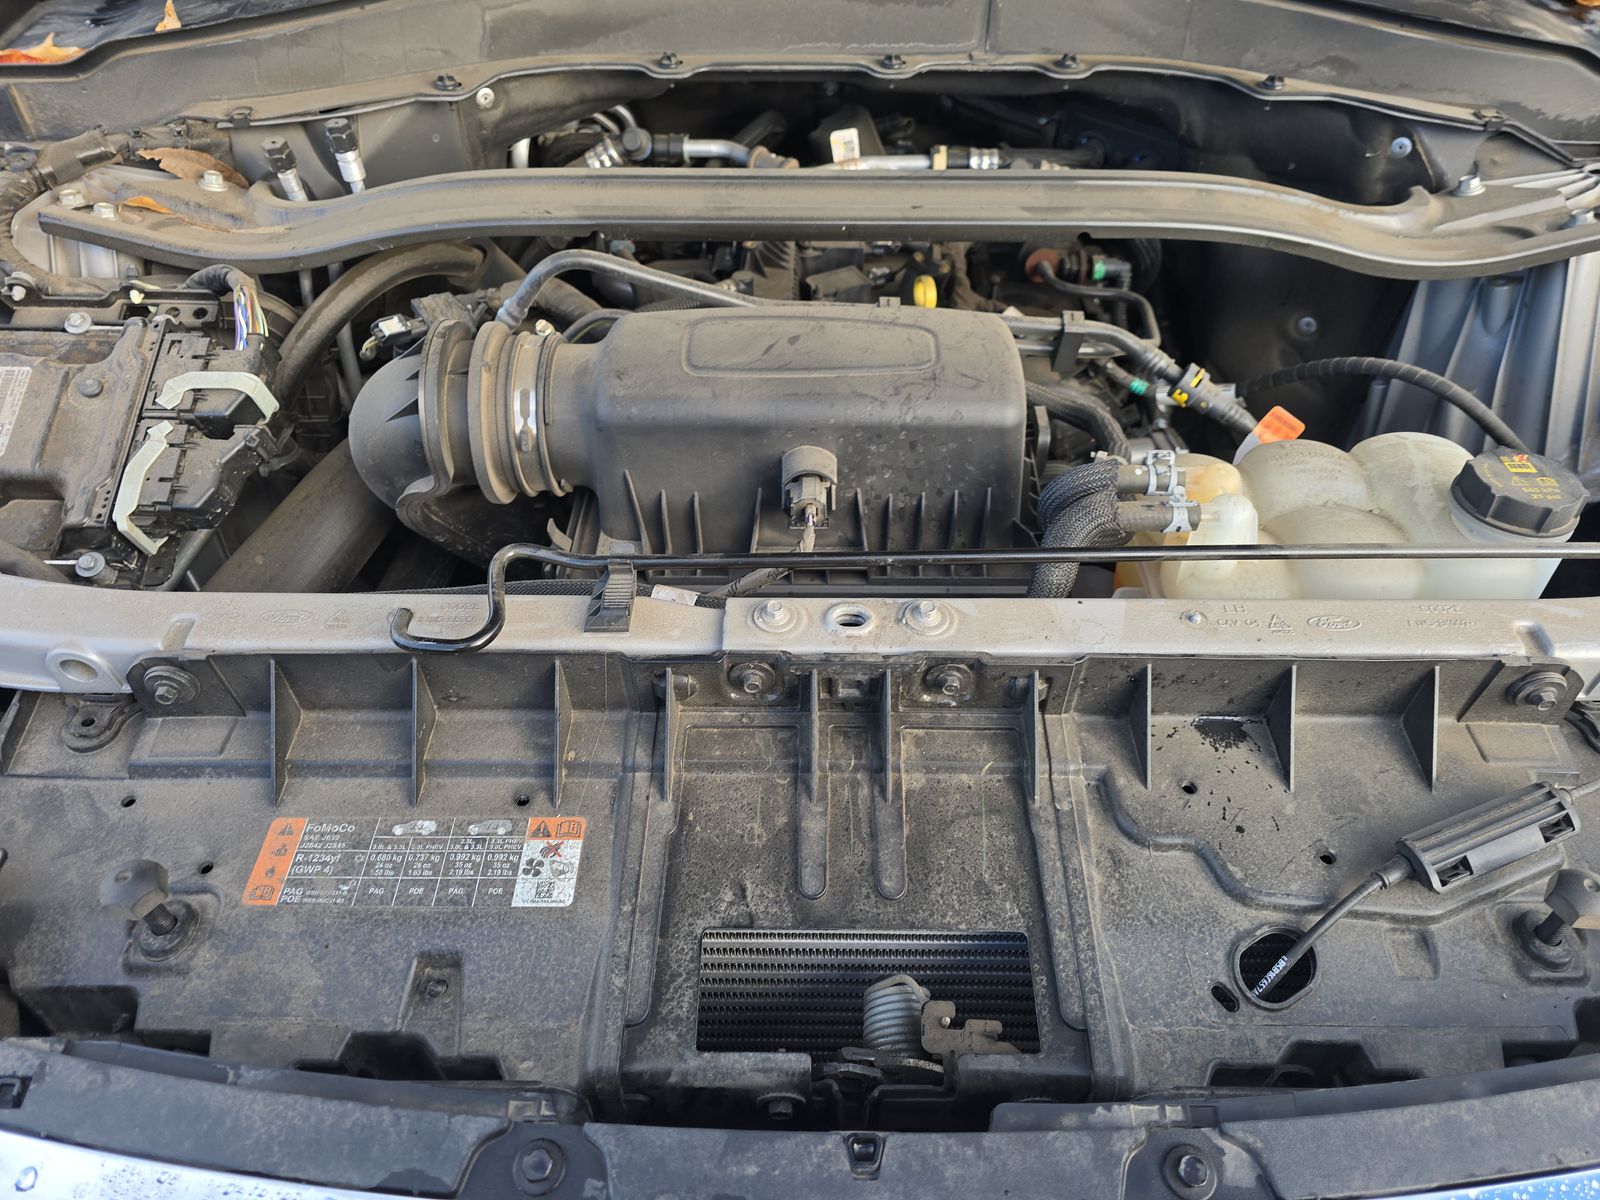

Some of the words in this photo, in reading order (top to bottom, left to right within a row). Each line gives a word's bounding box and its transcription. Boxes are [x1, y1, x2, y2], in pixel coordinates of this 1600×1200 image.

[305, 823, 356, 833] FoMoCo
[295, 853, 342, 864] R-1234yf
[392, 853, 403, 862] kg
[430, 853, 441, 862] kg
[471, 853, 481, 862] kg
[509, 853, 519, 862] kg
[291, 865, 321, 875] (GWP
[322, 865, 334, 875] 4)
[283, 887, 304, 896] PAG
[408, 887, 425, 895] POE
[448, 887, 464, 895] PAG
[487, 887, 504, 895] POE
[280, 895, 301, 903] POE
